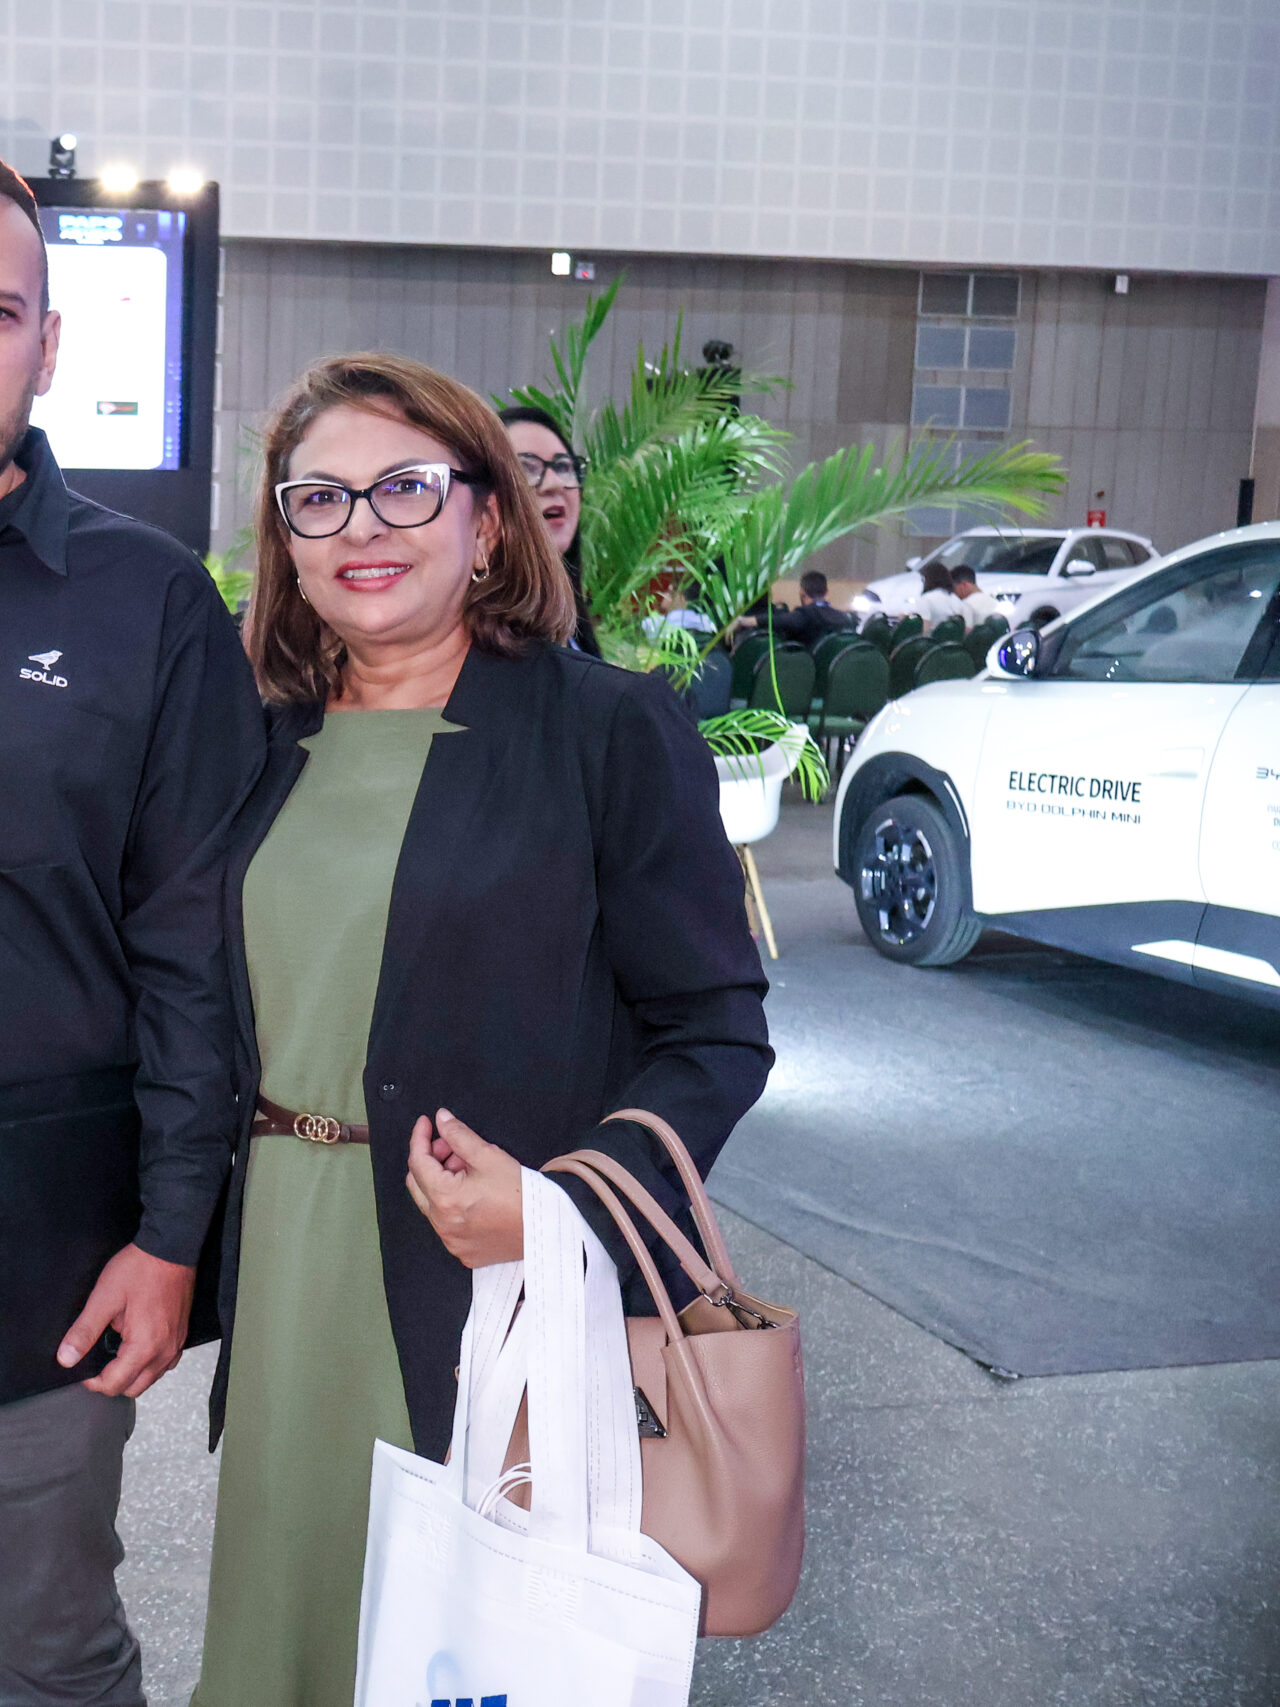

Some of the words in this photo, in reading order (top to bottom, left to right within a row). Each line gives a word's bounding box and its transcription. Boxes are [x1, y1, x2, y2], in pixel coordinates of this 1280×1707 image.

[19, 668, 68, 687] SOLID
[1009, 770, 1085, 797] ELECTRIC
[1089, 778, 1142, 803] DRIVE
[1006, 800, 1037, 812] BYD
[1041, 803, 1106, 820] DOLPHIN
[1111, 811, 1141, 824] MINI
